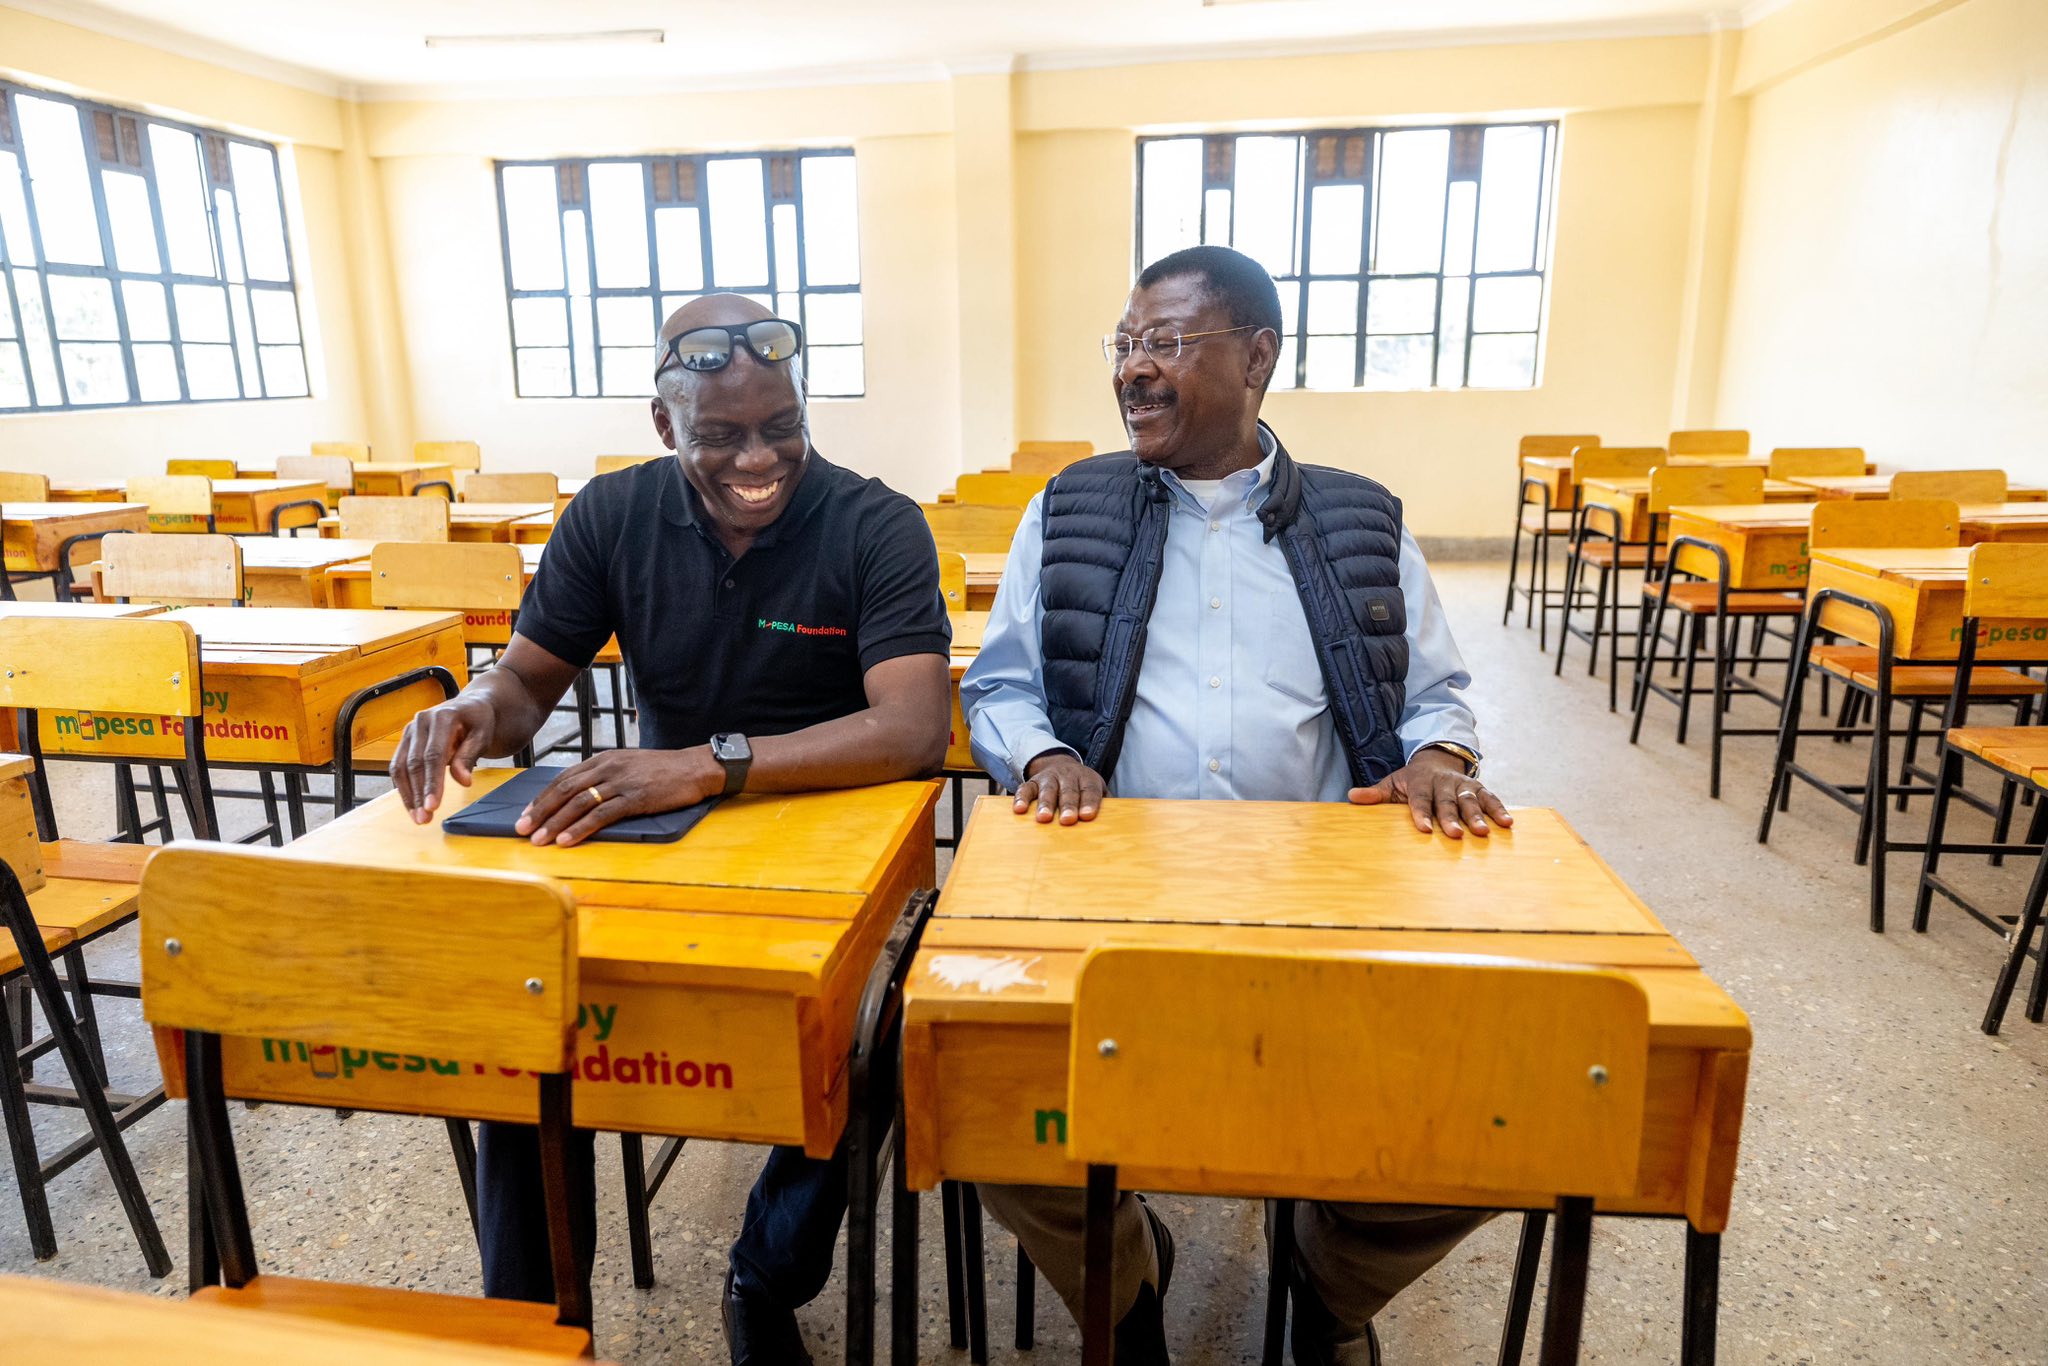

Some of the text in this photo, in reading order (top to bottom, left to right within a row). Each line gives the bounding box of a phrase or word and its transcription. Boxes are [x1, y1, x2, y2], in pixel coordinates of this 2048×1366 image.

[796, 623, 847, 636] Foundation
[160, 716, 289, 741] Fondation
[474, 1043, 734, 1090] dation
